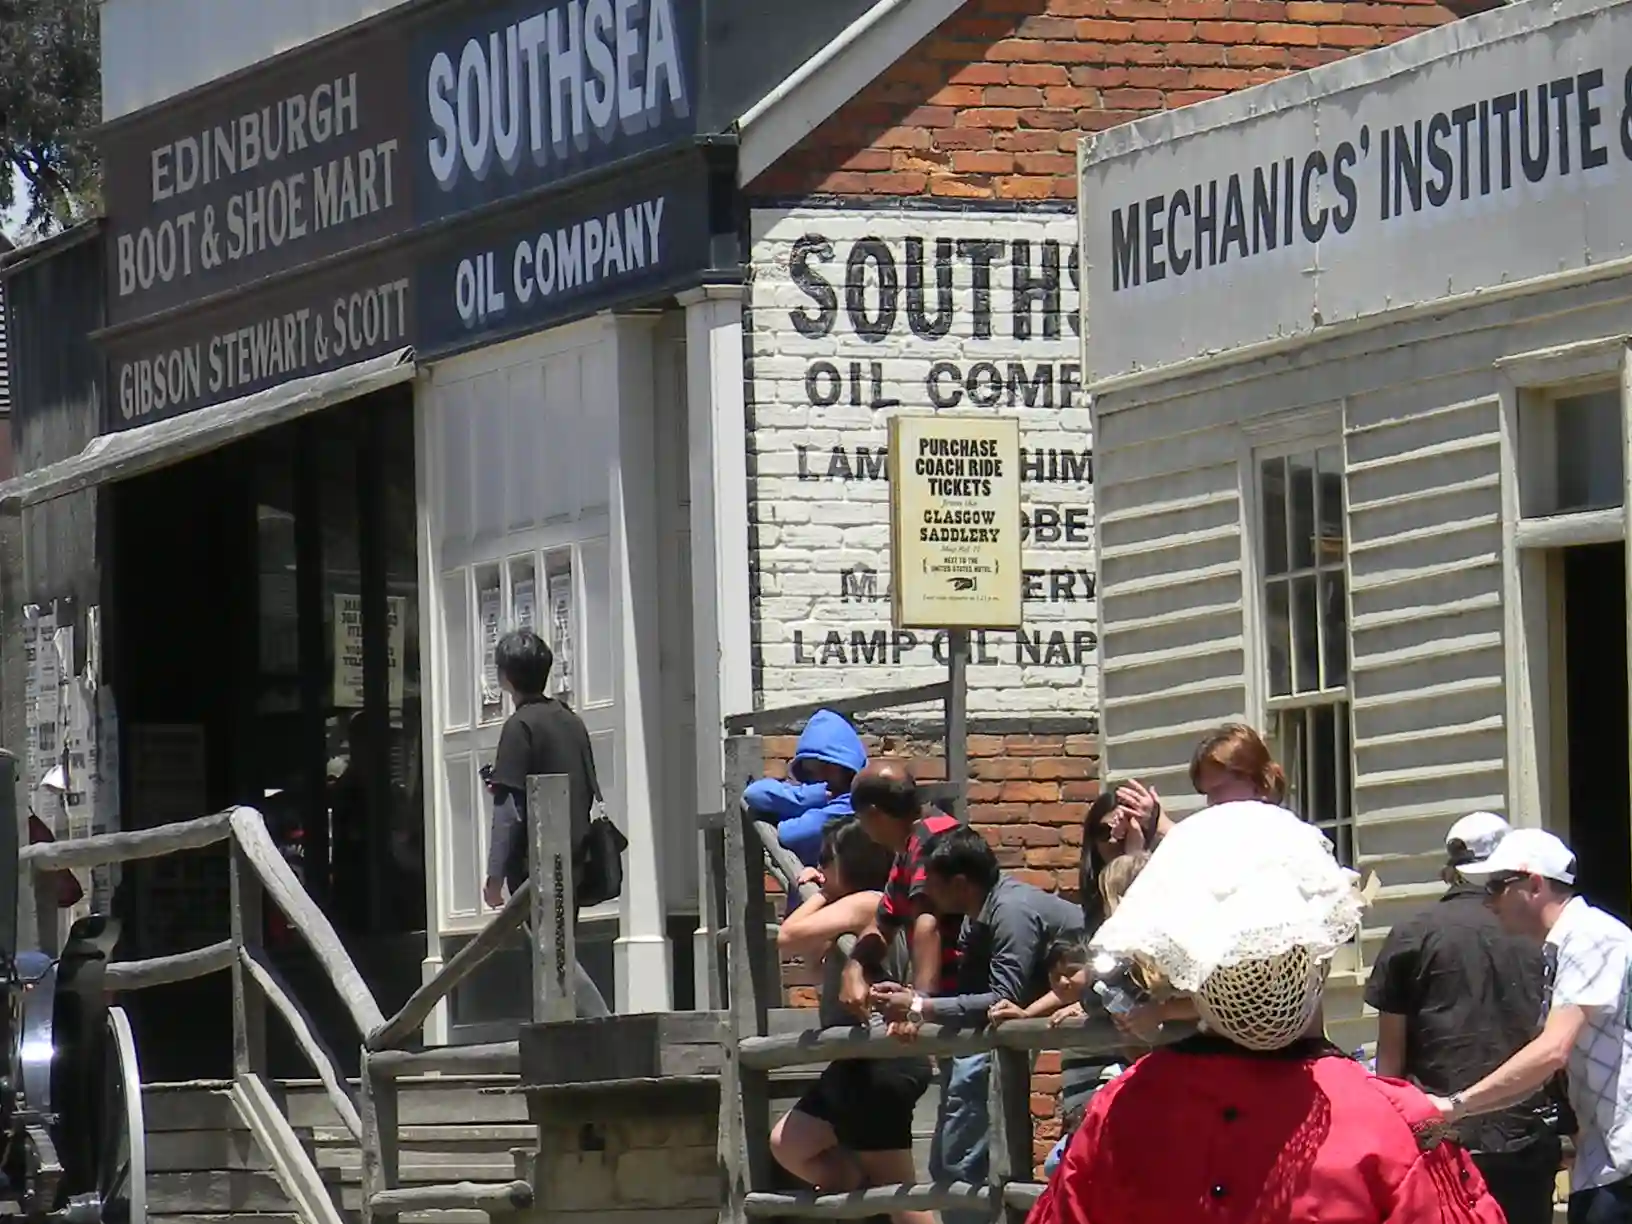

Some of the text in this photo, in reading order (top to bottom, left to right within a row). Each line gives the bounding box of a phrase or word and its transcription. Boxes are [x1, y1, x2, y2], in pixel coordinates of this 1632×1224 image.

[428, 0, 682, 182] SOUTHSEA
[152, 73, 357, 202] EDINBURGH
[1112, 124, 1370, 291] MECHANICS'
[1380, 68, 1608, 220] INSTITUTE
[118, 138, 398, 296] BOOT & SHOE MART
[456, 197, 664, 320] OIL COMPANY
[120, 278, 409, 420] GIBSON STEWART & SCOTT
[804, 361, 900, 409] OIL
[915, 458, 1003, 477] COACH RIDE
[919, 438, 998, 457] PURCHASE
[928, 478, 991, 497] TICKETS
[920, 528, 1000, 543] SADDLERY
[924, 510, 996, 524] GLASGOW
[794, 630, 918, 664] LAMP
